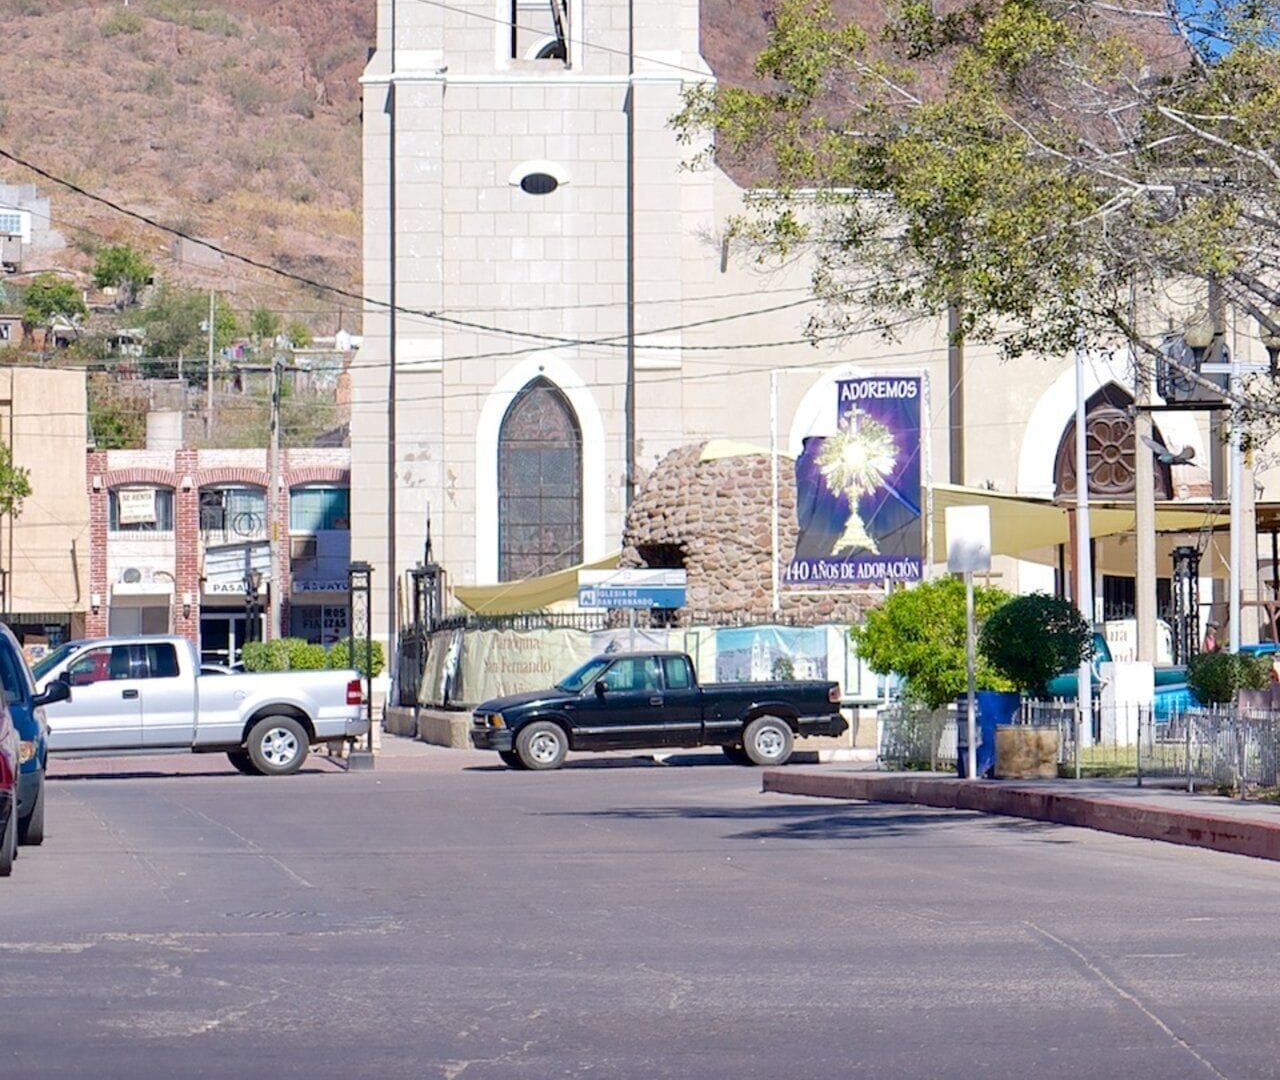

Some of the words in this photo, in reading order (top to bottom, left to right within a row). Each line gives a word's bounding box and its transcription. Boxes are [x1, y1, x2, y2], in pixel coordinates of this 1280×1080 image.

[840, 380, 918, 401] ADOREMOS
[787, 560, 810, 580] 140
[811, 560, 839, 579] AÑOS
[841, 562, 856, 579] DE
[857, 557, 920, 579] ADORACIÓN
[213, 581, 247, 593] PASA
[597, 589, 627, 598] IGLESIA
[628, 589, 638, 598] DE
[597, 598, 612, 606] SAN
[613, 598, 654, 606] FERNANDO
[502, 656, 552, 673] Fernando
